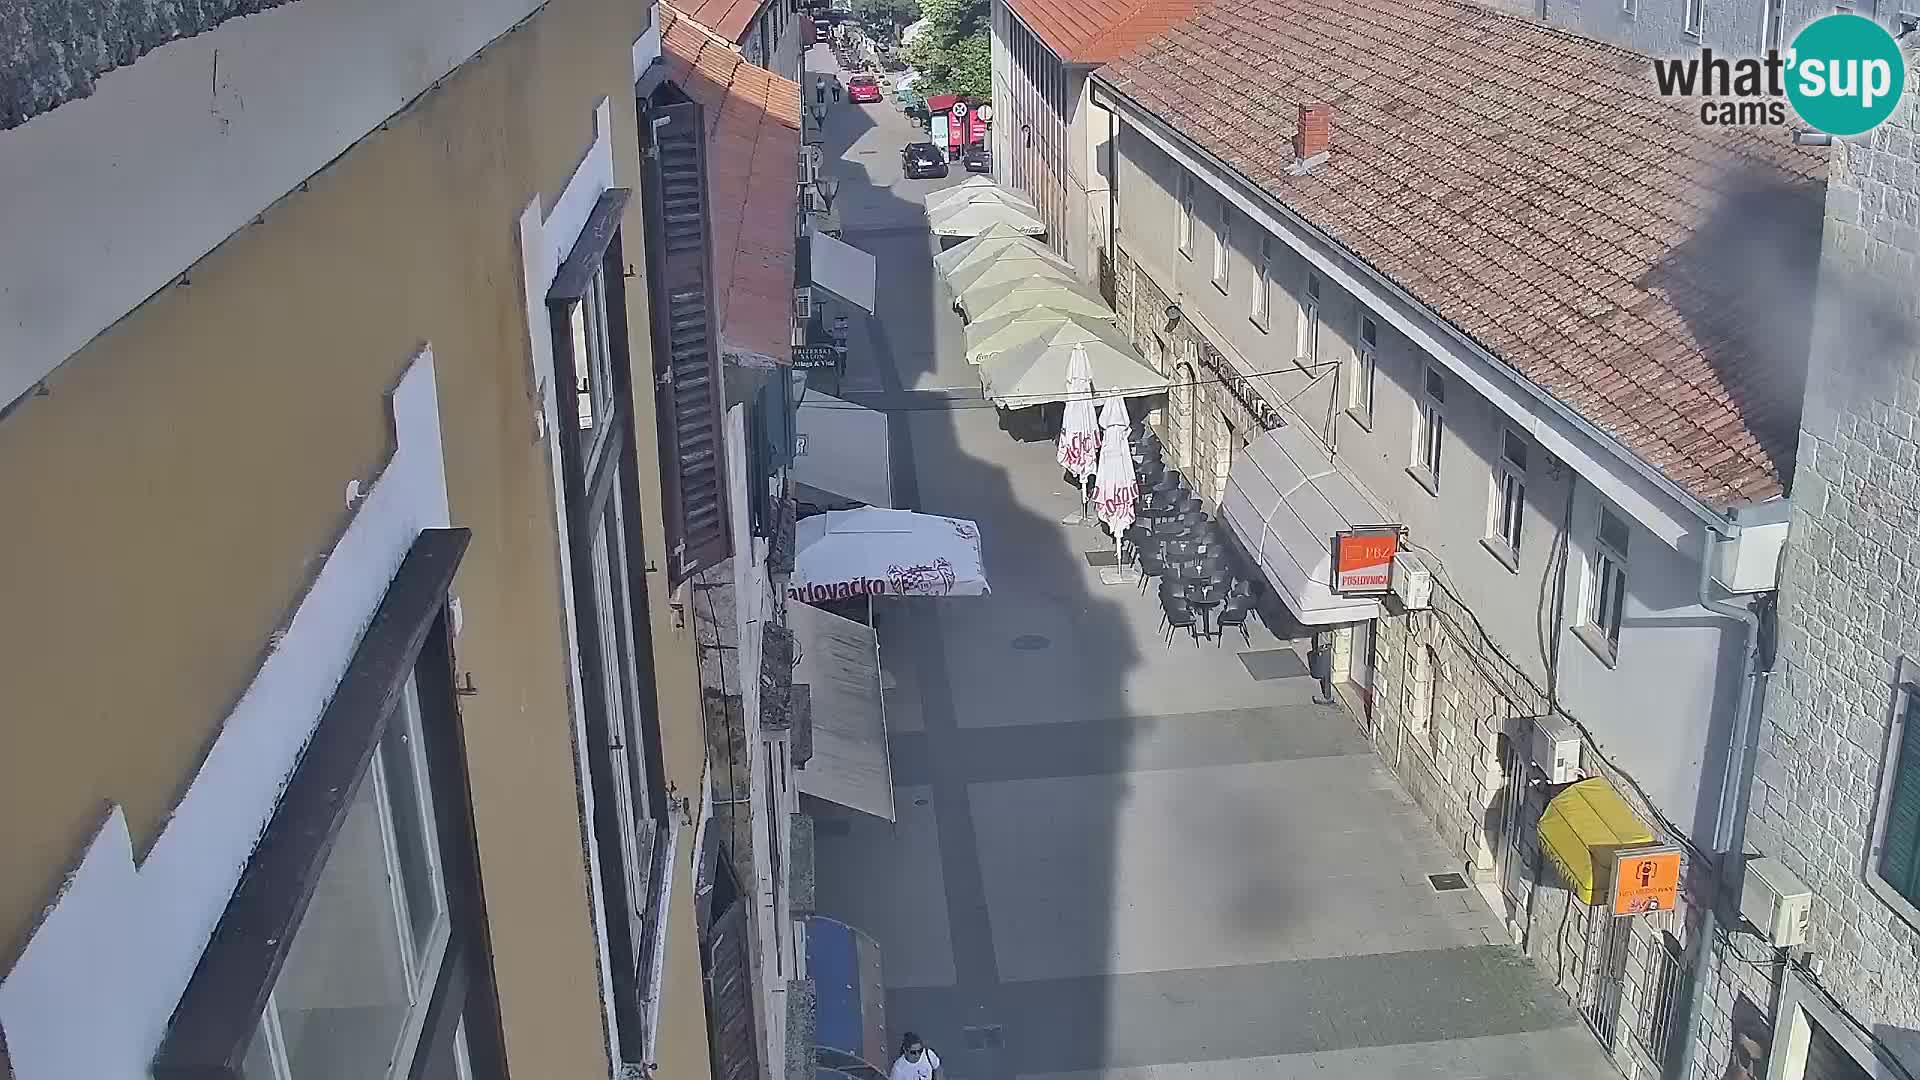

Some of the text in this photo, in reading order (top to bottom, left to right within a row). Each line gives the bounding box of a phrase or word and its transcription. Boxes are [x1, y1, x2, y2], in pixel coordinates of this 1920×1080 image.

[1366, 547, 1390, 559] PBZ
[1342, 575, 1388, 586] POSLOVNICA
[787, 576, 886, 602] arlovačko
